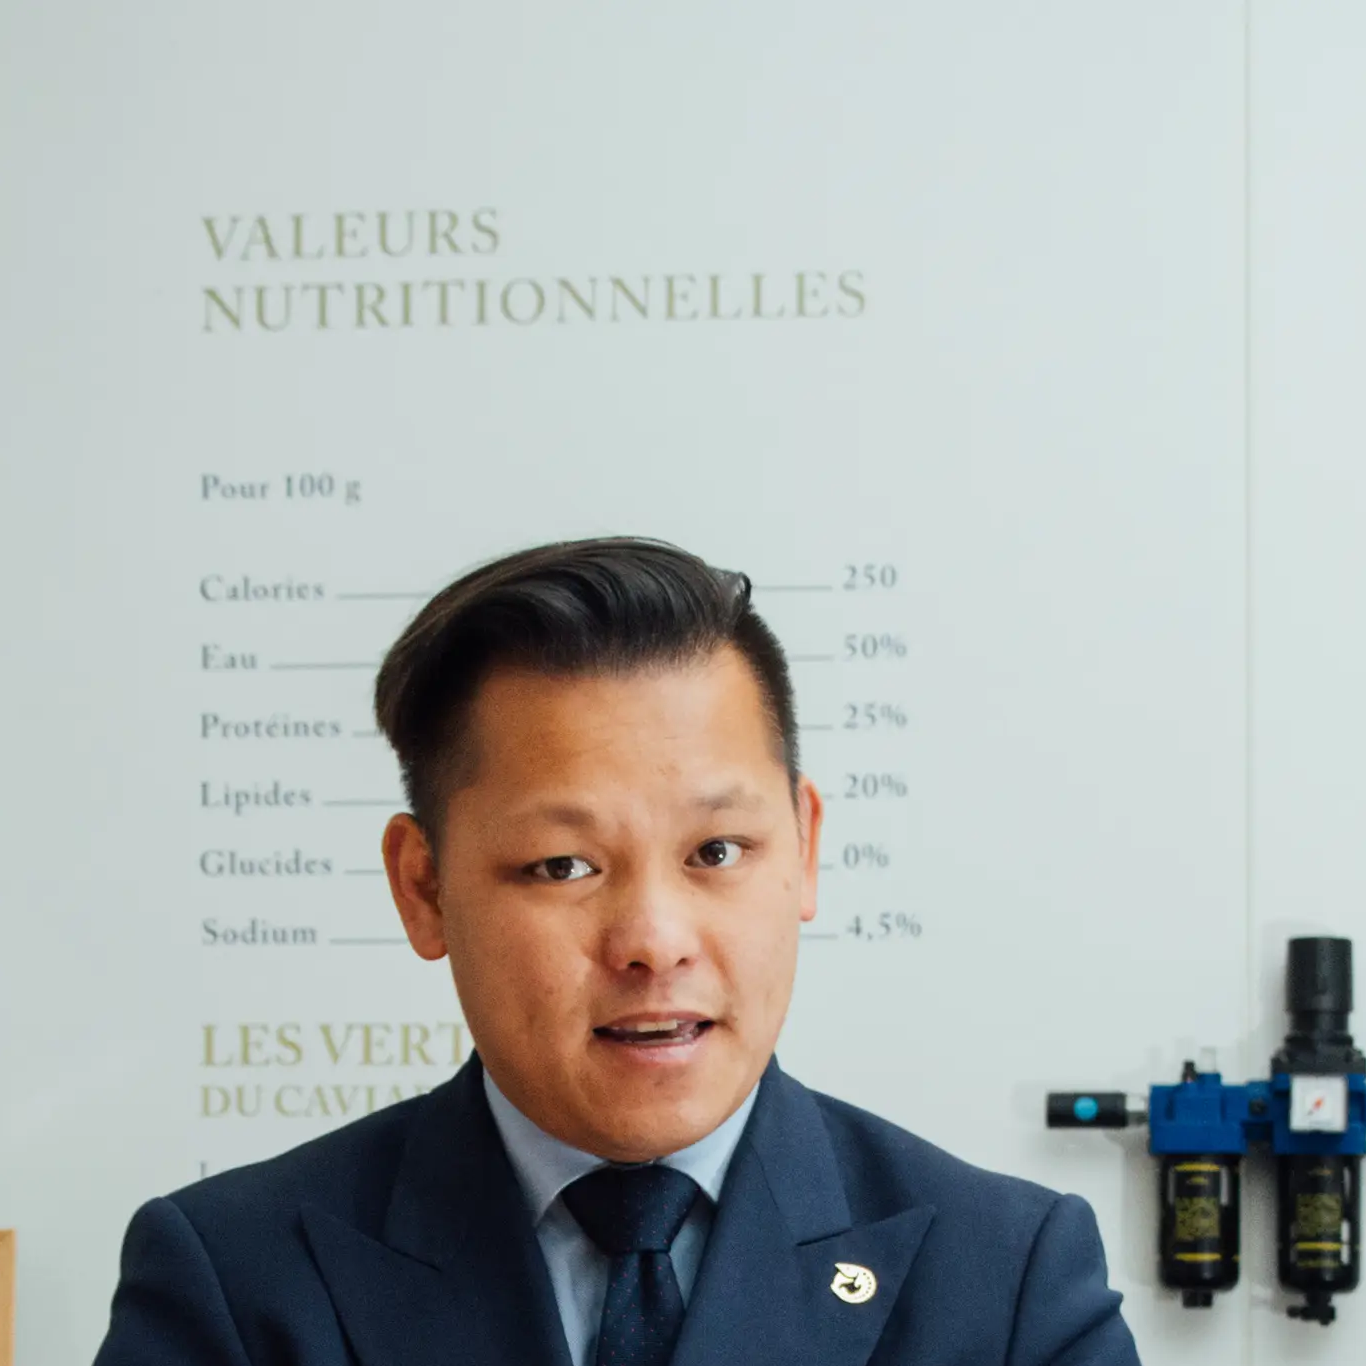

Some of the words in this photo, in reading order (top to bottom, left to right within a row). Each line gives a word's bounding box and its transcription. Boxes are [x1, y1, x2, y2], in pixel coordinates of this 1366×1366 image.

[201, 206, 501, 261] VALEURS
[200, 269, 869, 333] NUTRITIONNELLES
[201, 473, 269, 500] Pour
[285, 472, 335, 499] 100
[344, 479, 362, 507] g
[199, 574, 325, 602] Calories
[843, 563, 897, 591] 250
[200, 644, 258, 670] Eau
[844, 632, 908, 660] 50%
[200, 712, 341, 739] Protéines
[844, 701, 908, 730] 25%
[200, 781, 311, 815] Lipides
[844, 773, 908, 799] 20%
[199, 848, 333, 876] Glucides
[843, 843, 889, 869] 0%
[202, 918, 317, 945] Sodium
[847, 911, 923, 941] 4,5%
[200, 1022, 304, 1068] LES
[199, 1084, 261, 1118] DU
